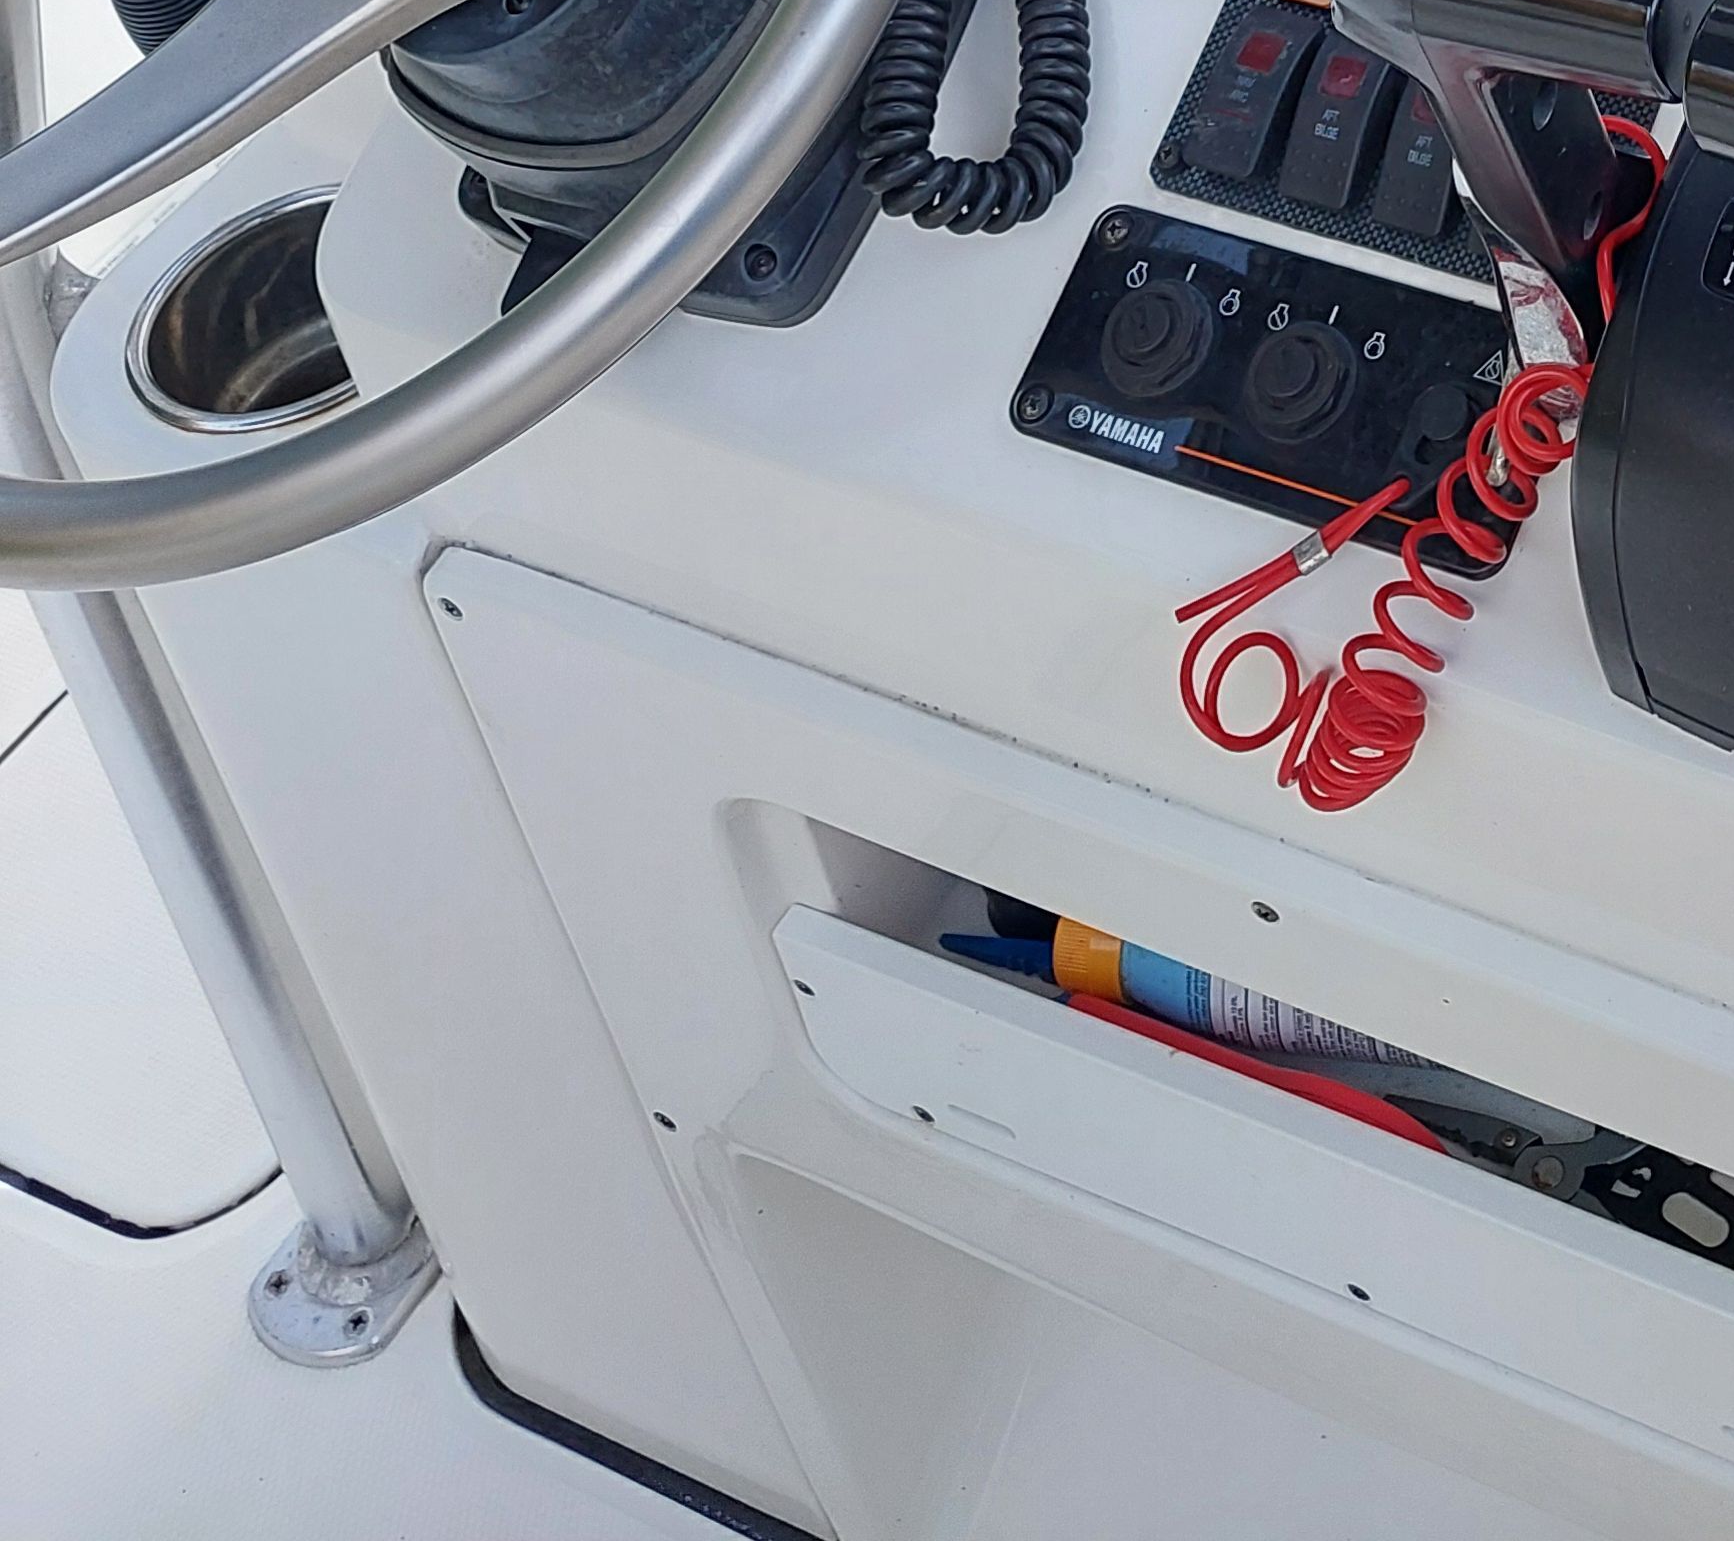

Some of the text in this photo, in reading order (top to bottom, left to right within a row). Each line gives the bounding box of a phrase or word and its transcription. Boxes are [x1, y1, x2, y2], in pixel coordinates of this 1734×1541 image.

[1322, 109, 1340, 121] AFT
[1313, 123, 1340, 141] BILGE
[1415, 135, 1433, 149] AFT
[1407, 148, 1433, 167] BILGE
[1089, 410, 1165, 454] YAMAHA
